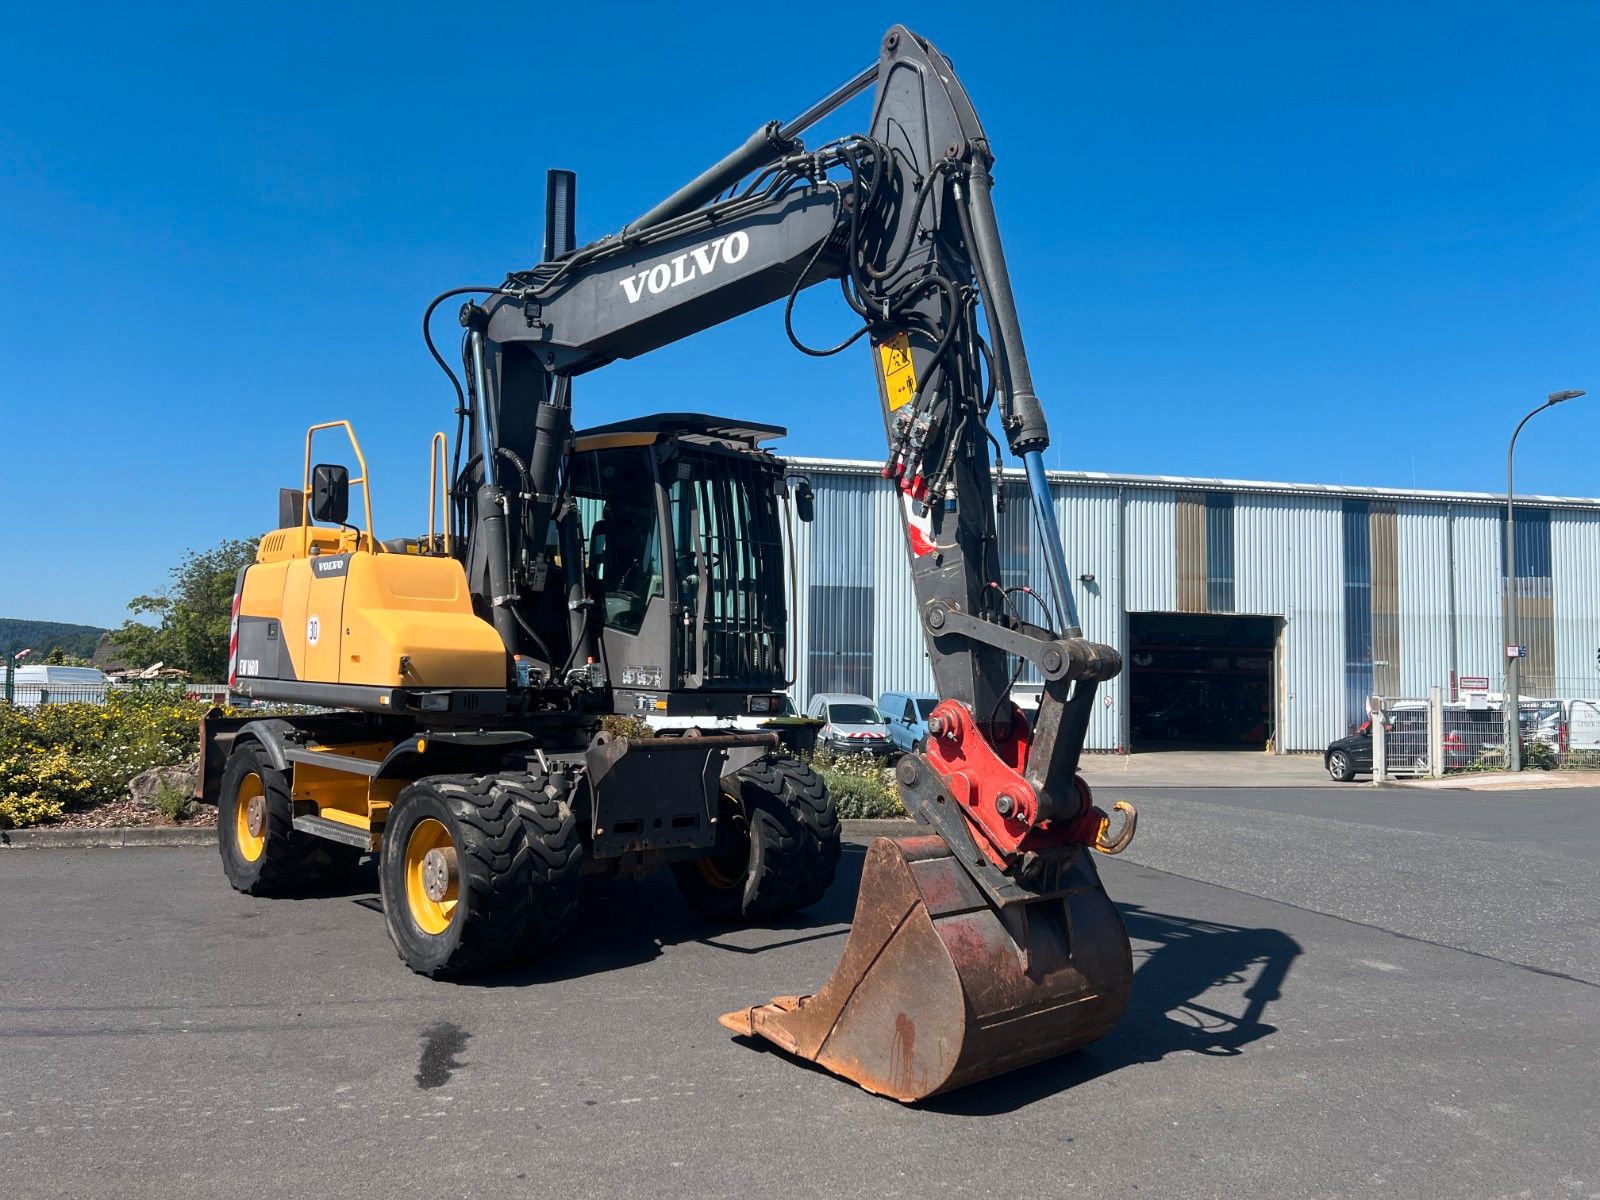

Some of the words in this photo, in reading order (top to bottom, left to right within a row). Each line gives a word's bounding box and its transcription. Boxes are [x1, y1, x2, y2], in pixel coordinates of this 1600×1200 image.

[620, 231, 749, 303] VOLVO
[319, 560, 343, 571] VOLVO
[309, 621, 317, 640] 30
